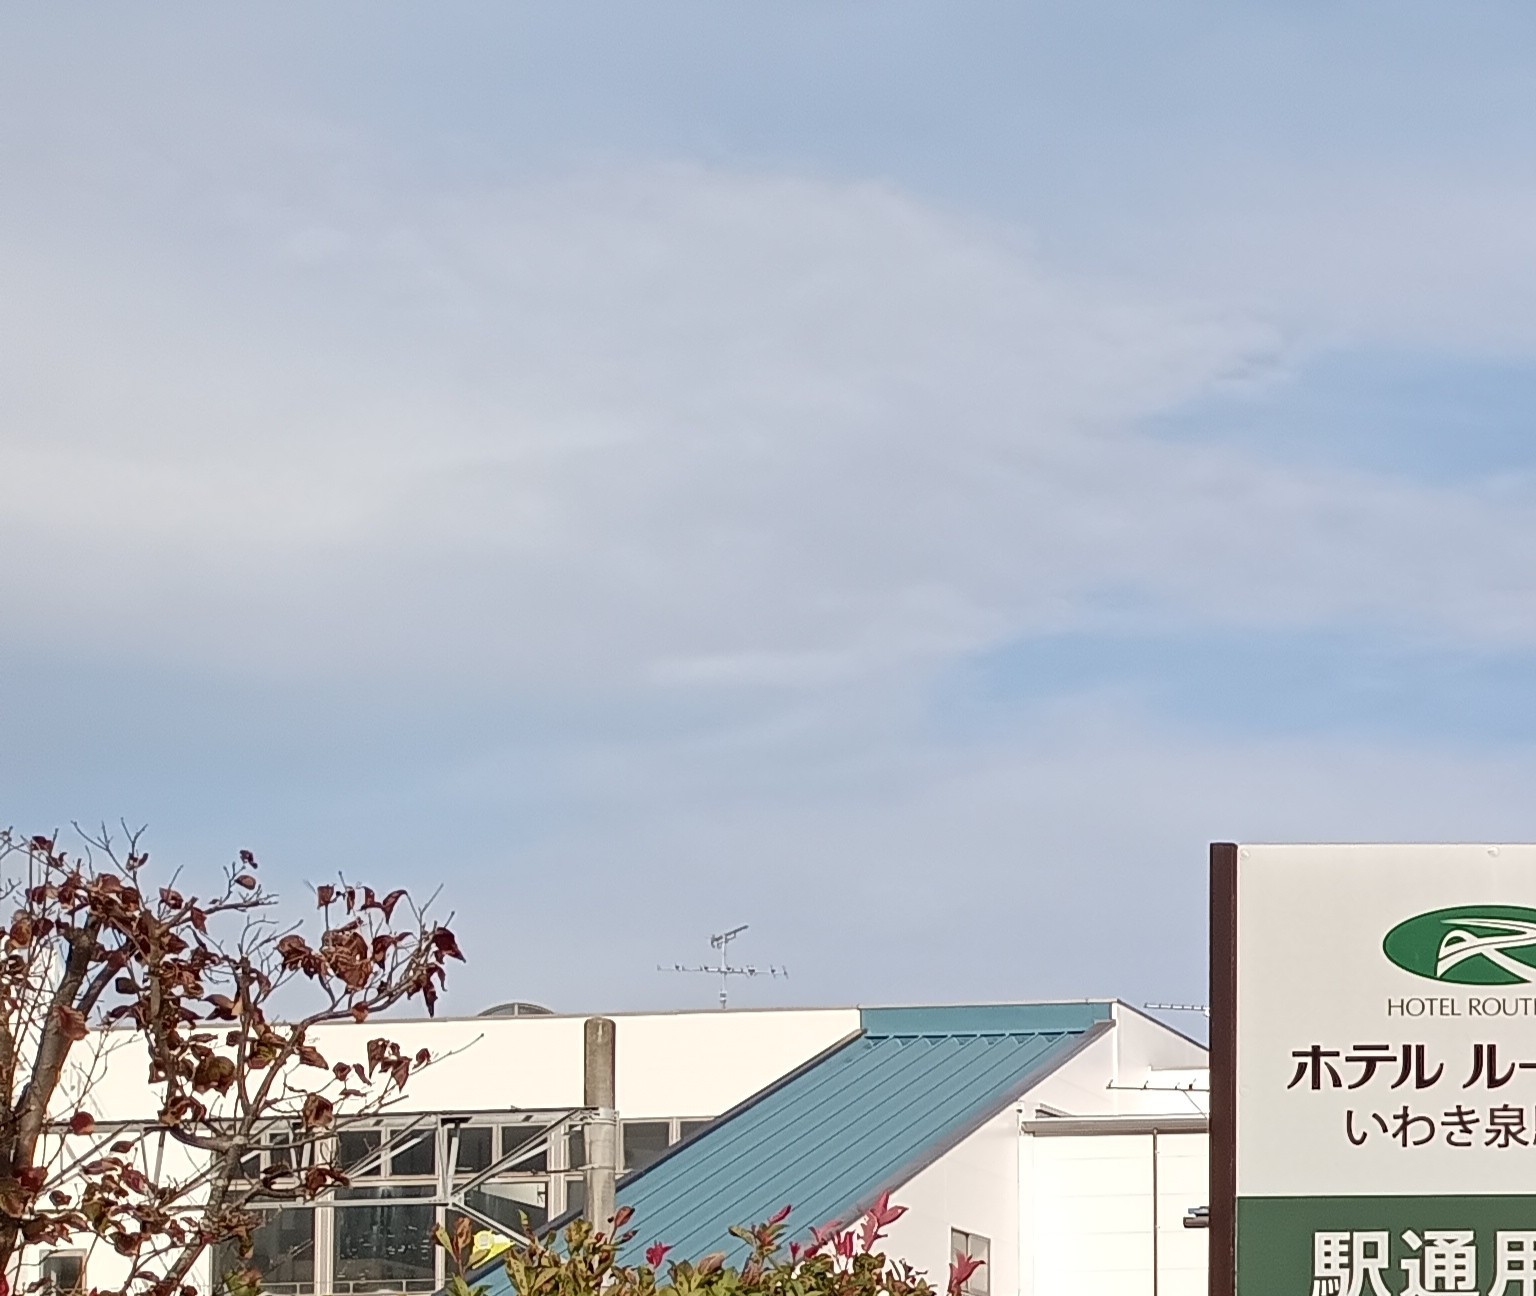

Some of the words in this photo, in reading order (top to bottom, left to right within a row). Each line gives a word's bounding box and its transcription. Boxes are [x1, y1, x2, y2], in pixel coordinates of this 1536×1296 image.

[1387, 998, 1462, 1017] HOTEL
[1287, 1044, 1444, 1090] ホテル
